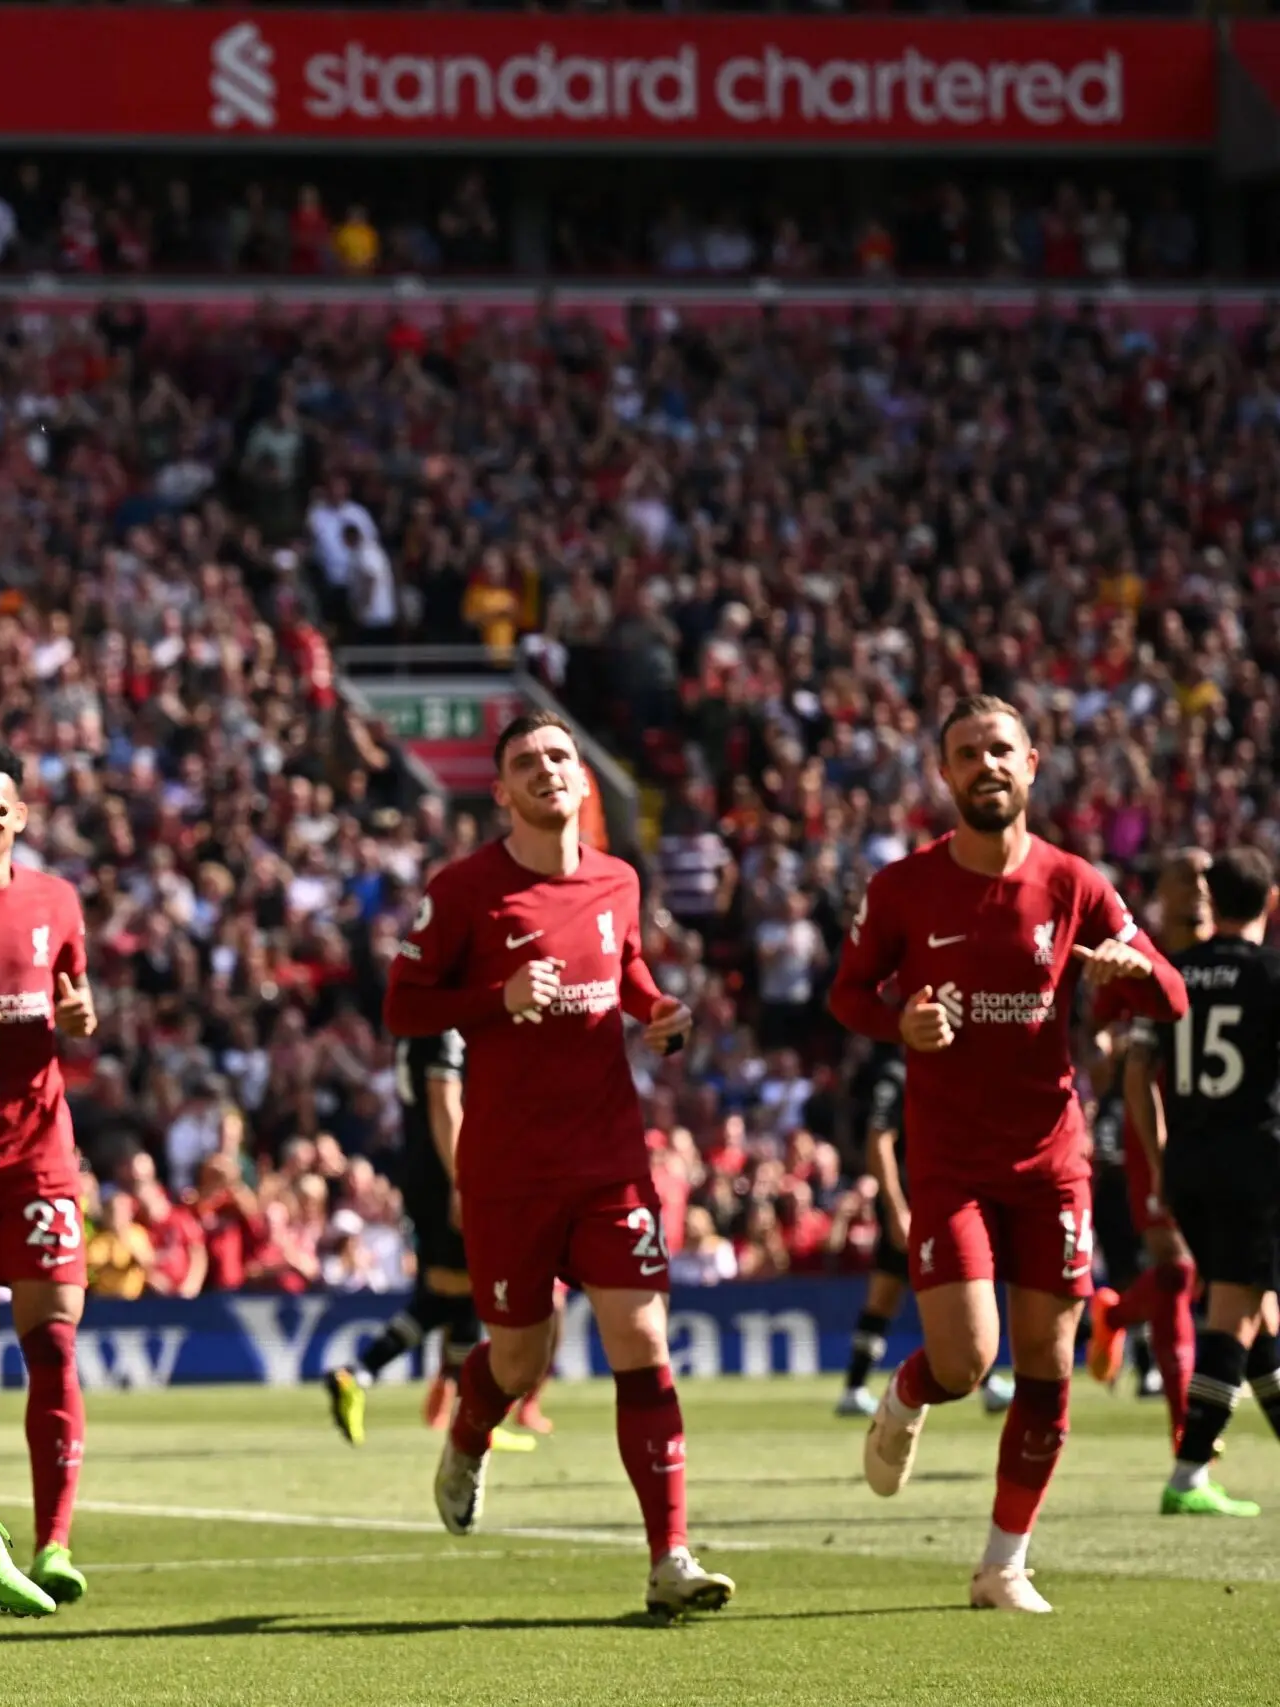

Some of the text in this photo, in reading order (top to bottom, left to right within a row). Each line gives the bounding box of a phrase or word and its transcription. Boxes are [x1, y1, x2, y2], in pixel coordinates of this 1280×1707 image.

[305, 41, 1122, 123] standard chartered
[1175, 1006, 1244, 1098] 15
[23, 1198, 81, 1249] 23
[1058, 1208, 1093, 1262] 14
